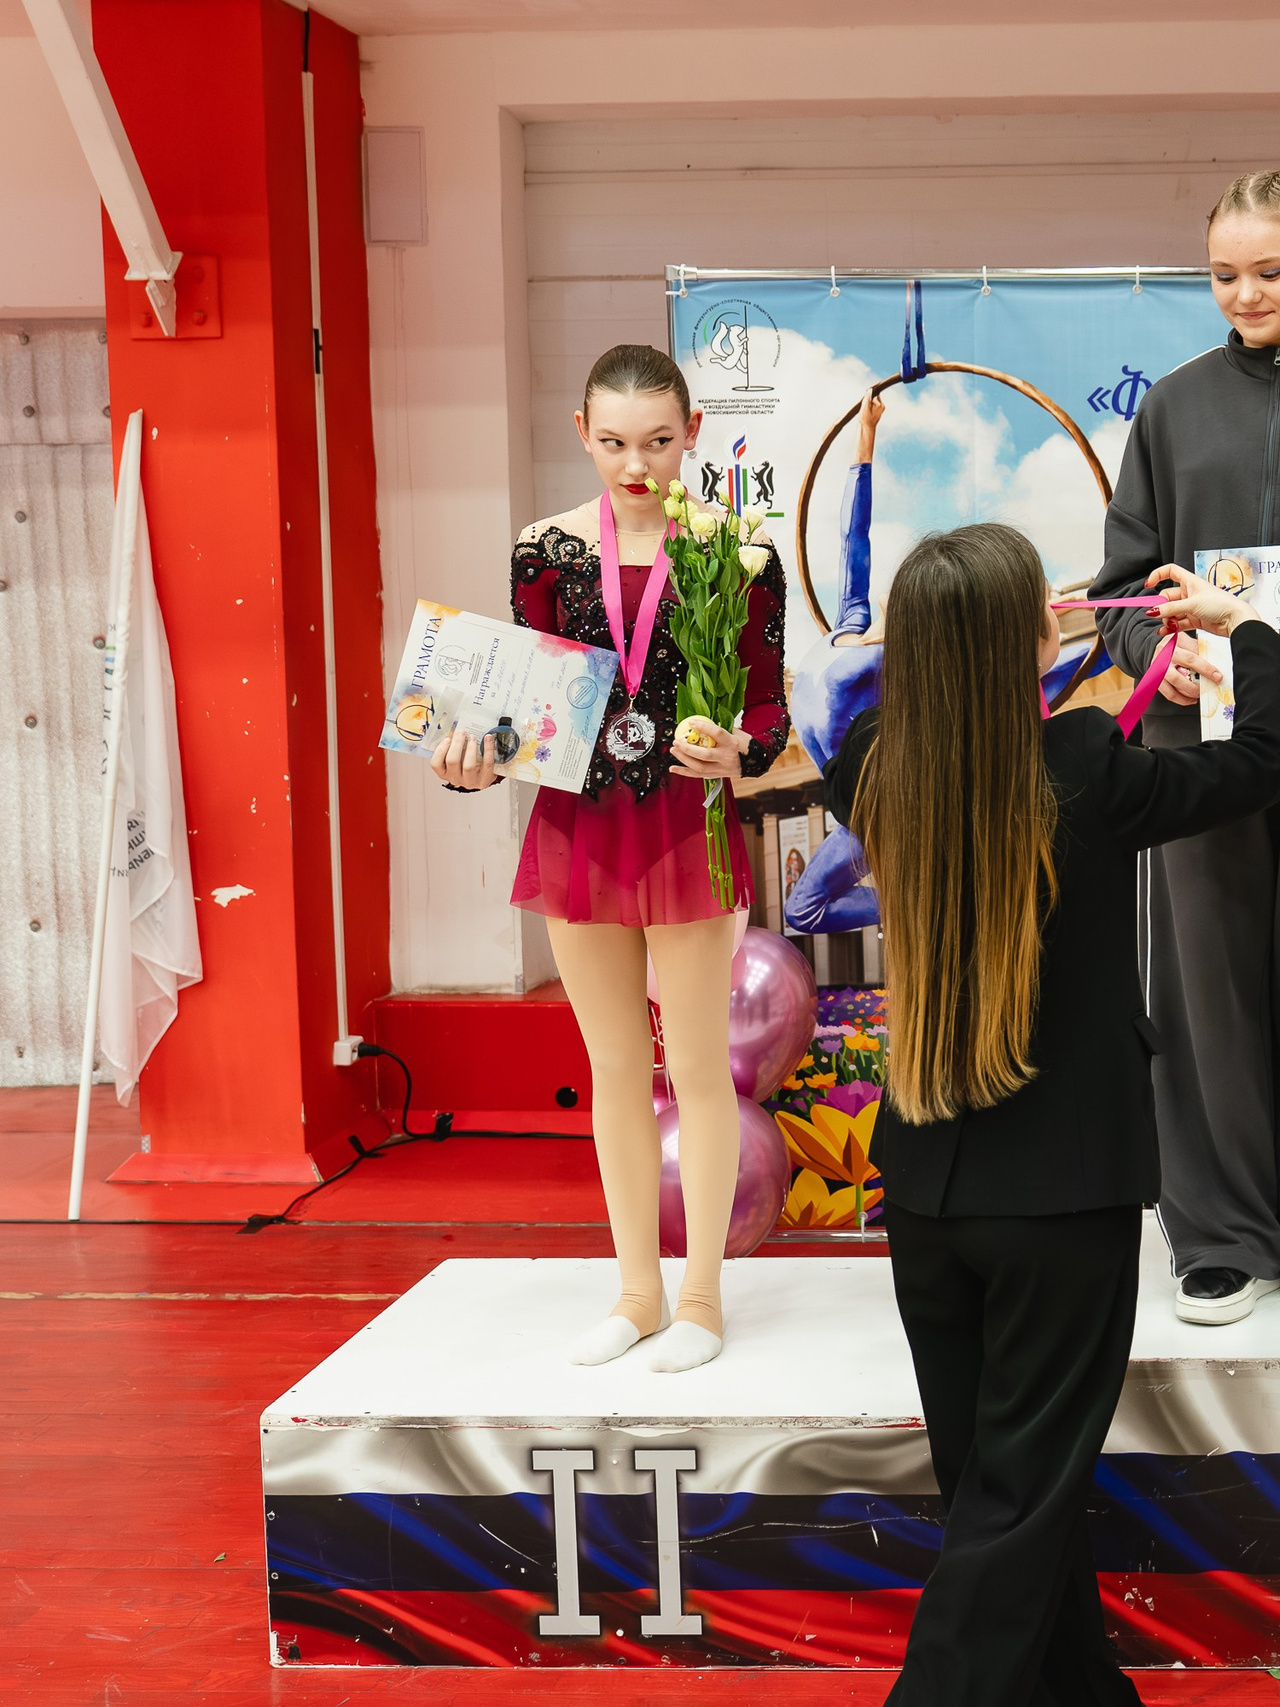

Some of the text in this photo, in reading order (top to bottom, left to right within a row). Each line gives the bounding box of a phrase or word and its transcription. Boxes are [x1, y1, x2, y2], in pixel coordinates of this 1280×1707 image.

[411, 617, 442, 689] ГРАМОТА
[473, 637, 500, 706] Награждается
[532, 1449, 702, 1636] II
